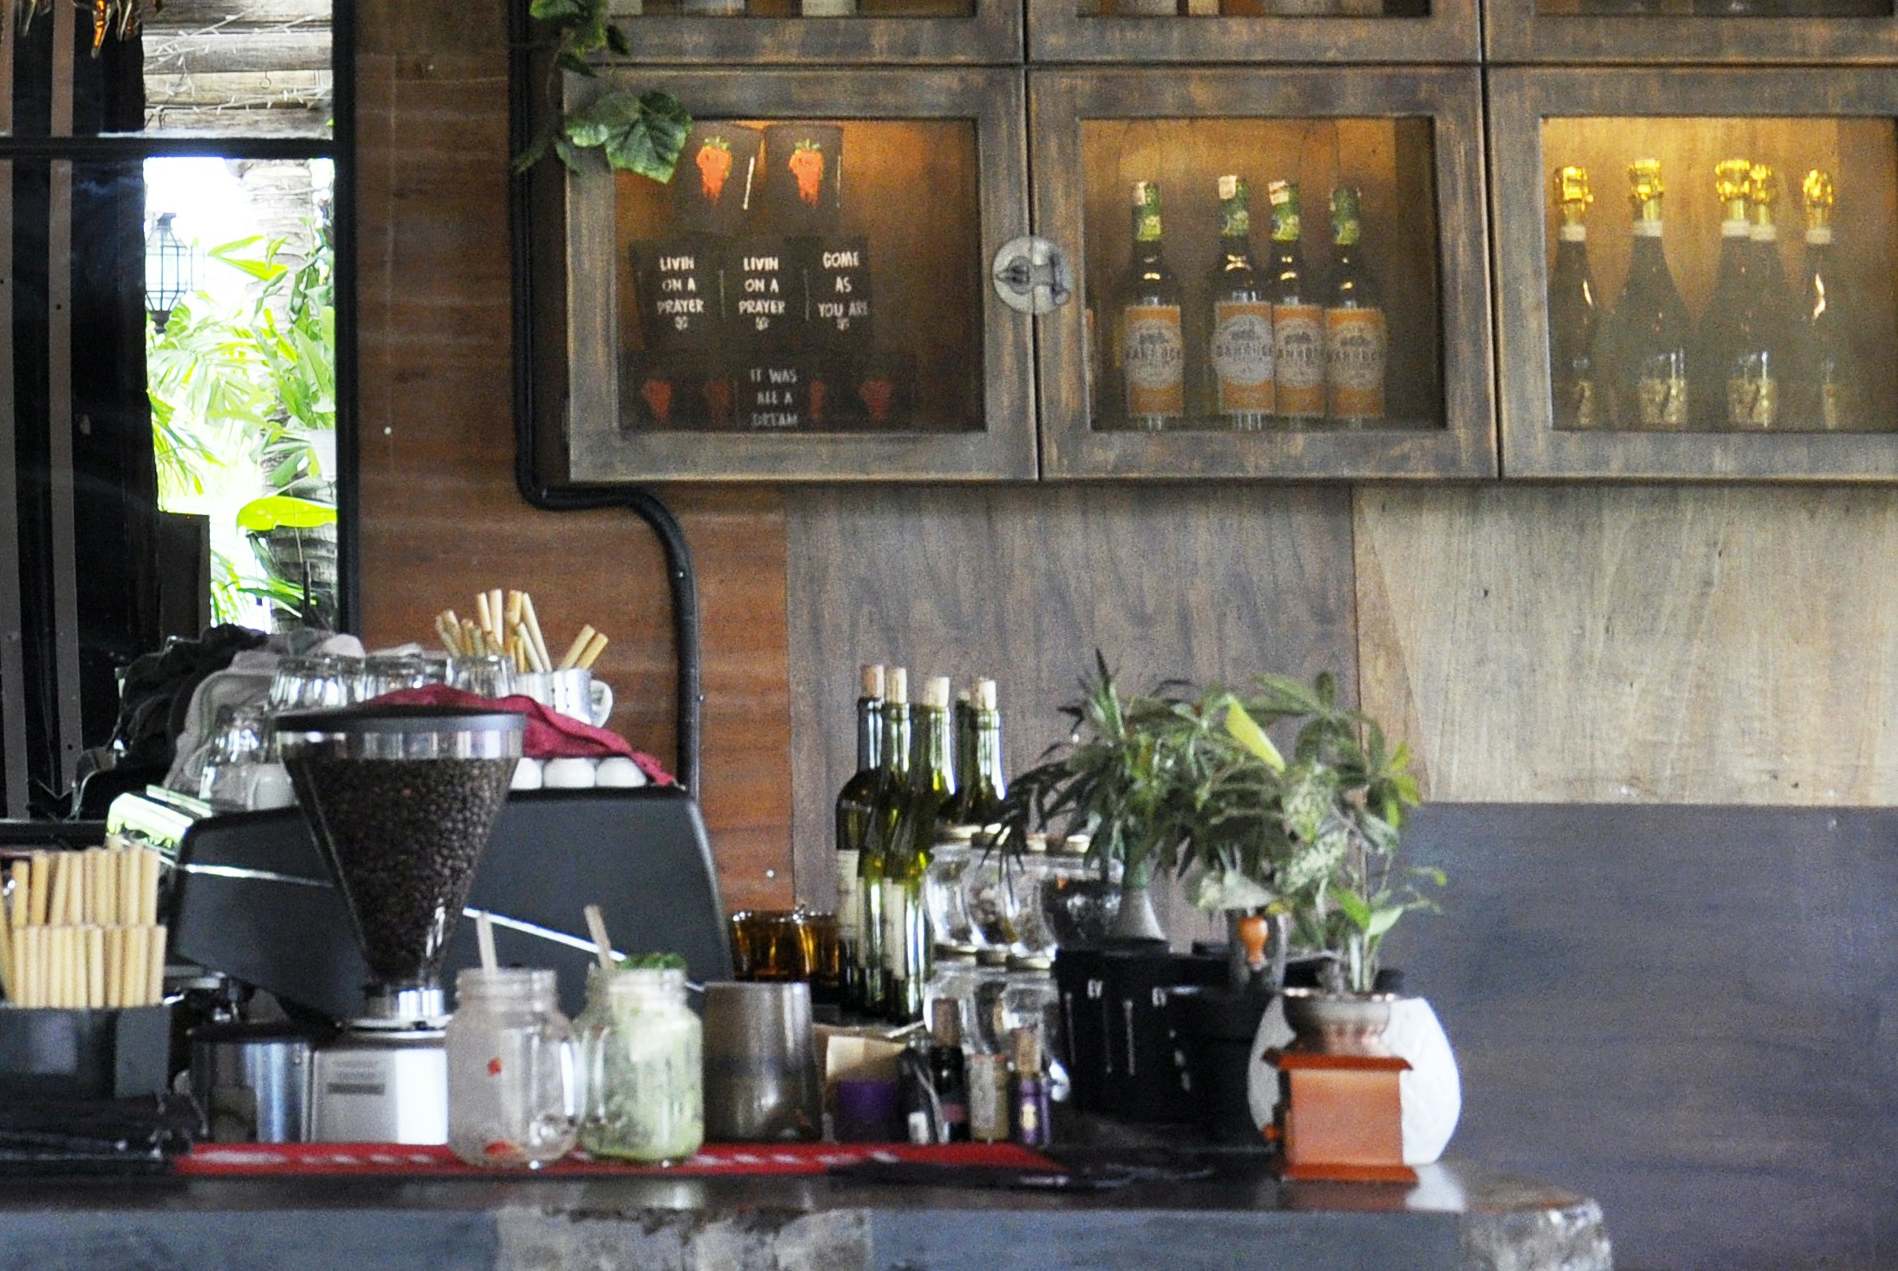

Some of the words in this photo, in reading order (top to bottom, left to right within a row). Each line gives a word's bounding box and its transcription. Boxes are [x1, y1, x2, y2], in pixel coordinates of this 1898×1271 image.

[659, 256, 695, 271] LIVIN
[743, 256, 779, 271] LIVIN
[822, 251, 860, 269] COME
[662, 278, 682, 292] ON
[687, 277, 697, 292] A
[744, 278, 765, 292] ON
[769, 277, 780, 293] A
[835, 276, 852, 293] AS
[656, 298, 704, 315] PRAYER
[738, 298, 786, 315] PRAYER
[818, 302, 844, 318] YOU
[768, 368, 798, 384] WAS
